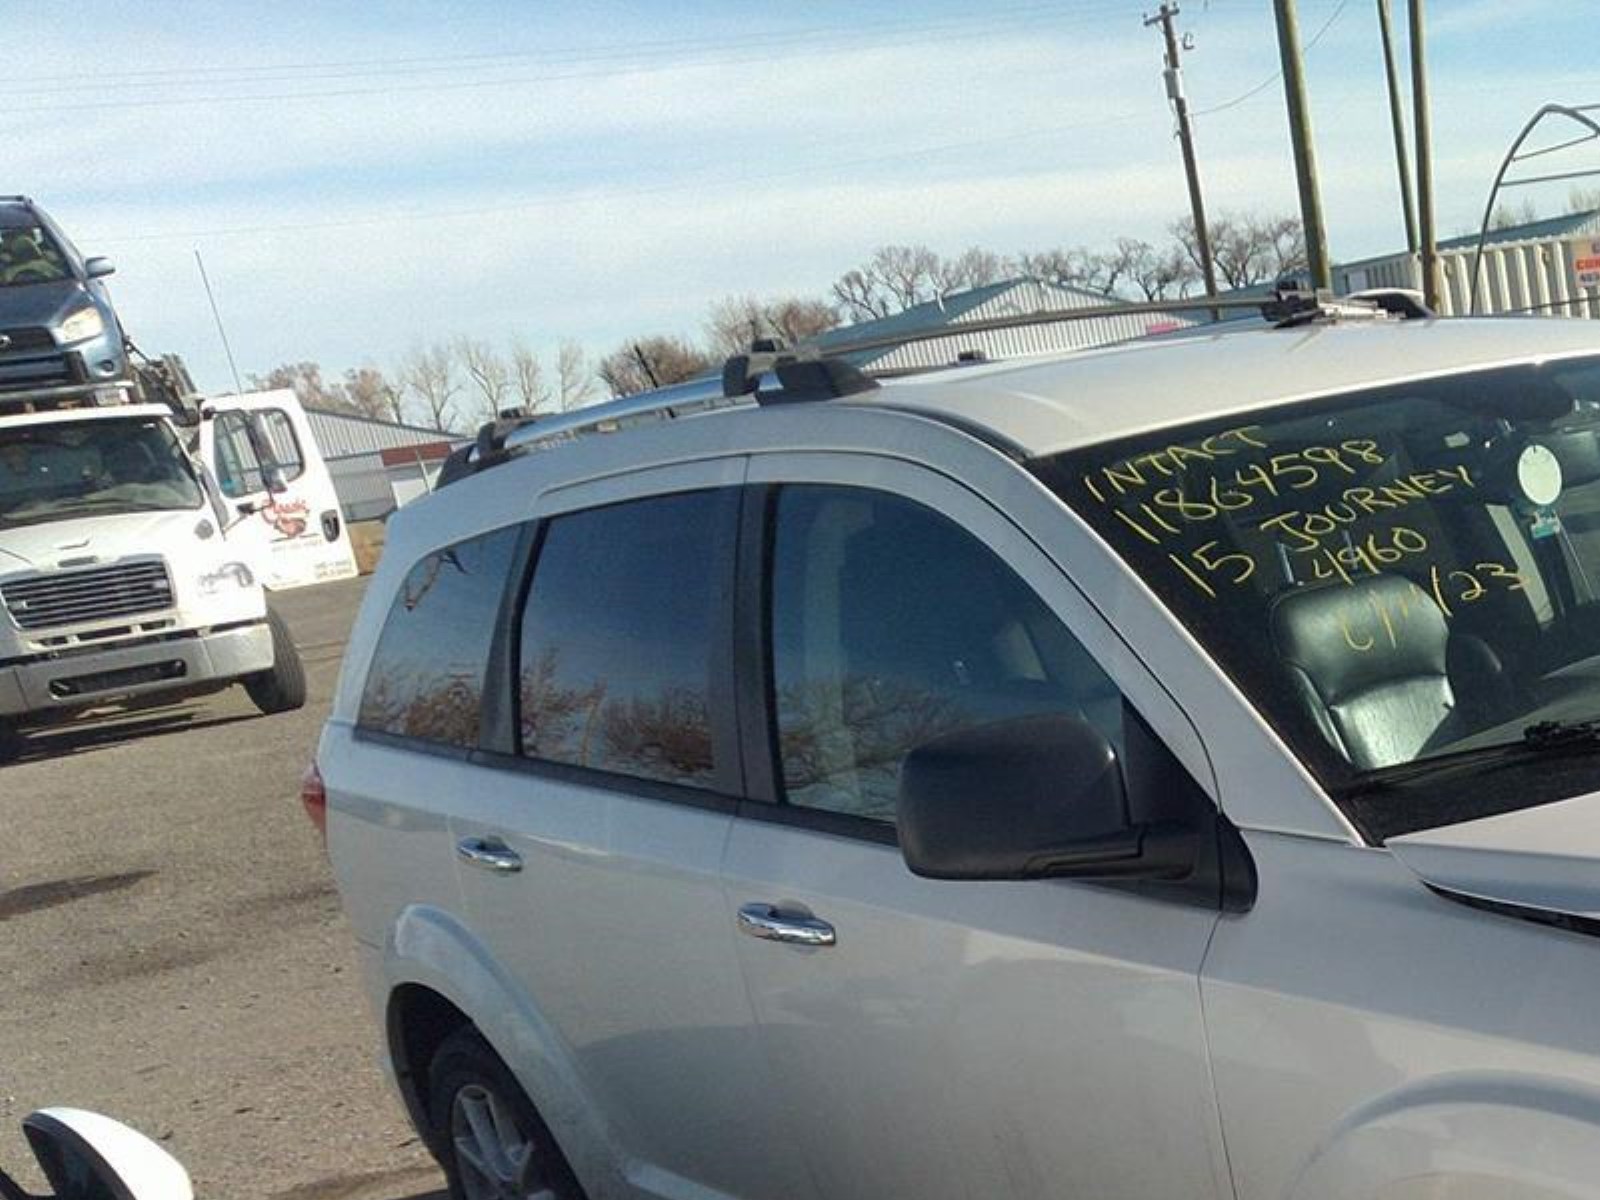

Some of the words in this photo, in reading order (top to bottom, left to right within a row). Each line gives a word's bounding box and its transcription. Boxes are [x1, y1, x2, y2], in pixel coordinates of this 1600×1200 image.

[1084, 425, 1268, 504] INTACT
[1113, 438, 1385, 545] 11864598
[1168, 540, 1256, 599] 15
[1259, 464, 1475, 553] JOURNEY
